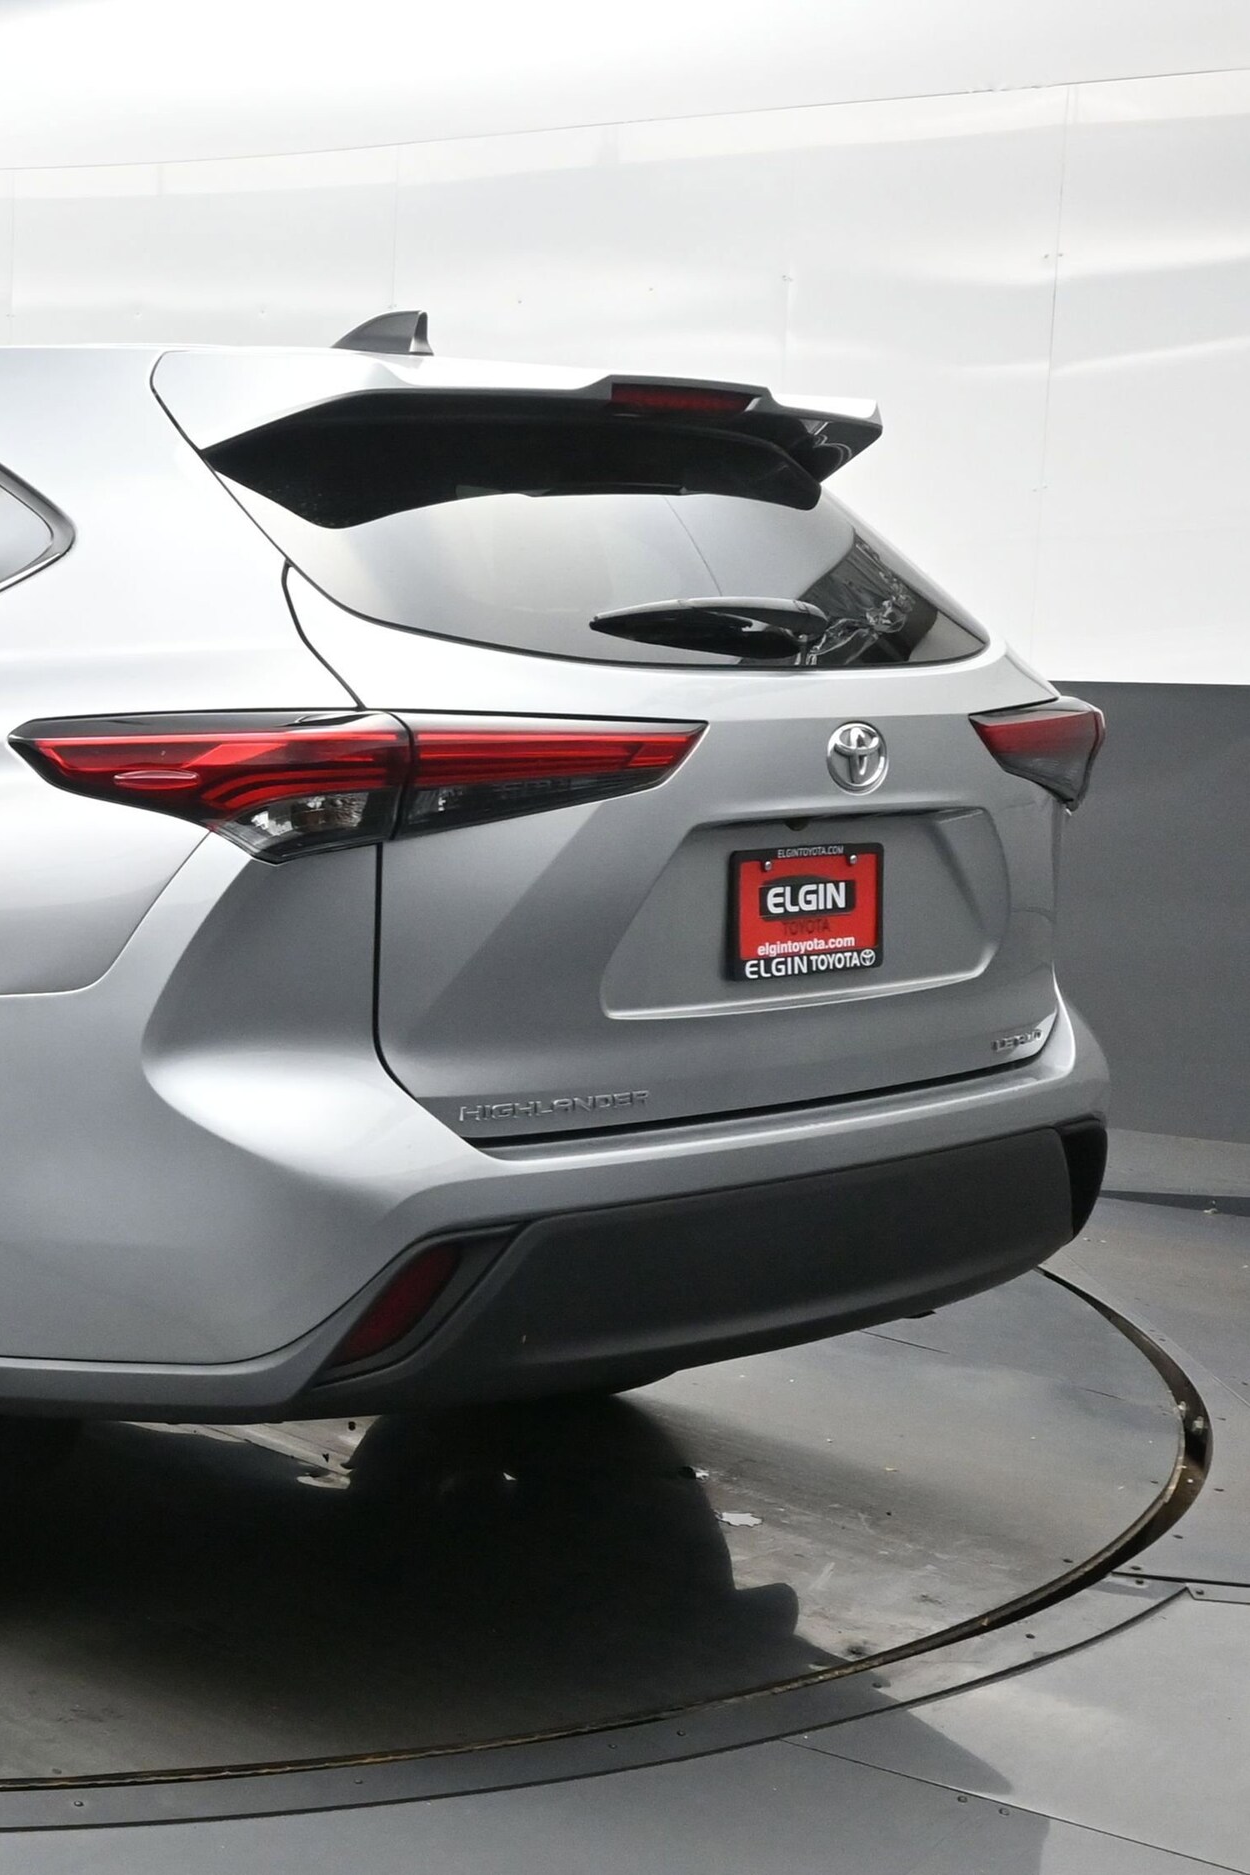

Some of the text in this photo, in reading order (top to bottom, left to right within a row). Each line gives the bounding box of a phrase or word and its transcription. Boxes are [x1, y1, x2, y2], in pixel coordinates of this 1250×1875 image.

[778, 846, 844, 858] ELGINTOYOTA.COM
[767, 882, 846, 914] ELGIN
[782, 919, 831, 936] TOYOTA
[757, 936, 855, 957] elgintoyota.com
[745, 952, 860, 979] ELGIN TOYOTA
[459, 1090, 649, 1121] HIGHLANDER
